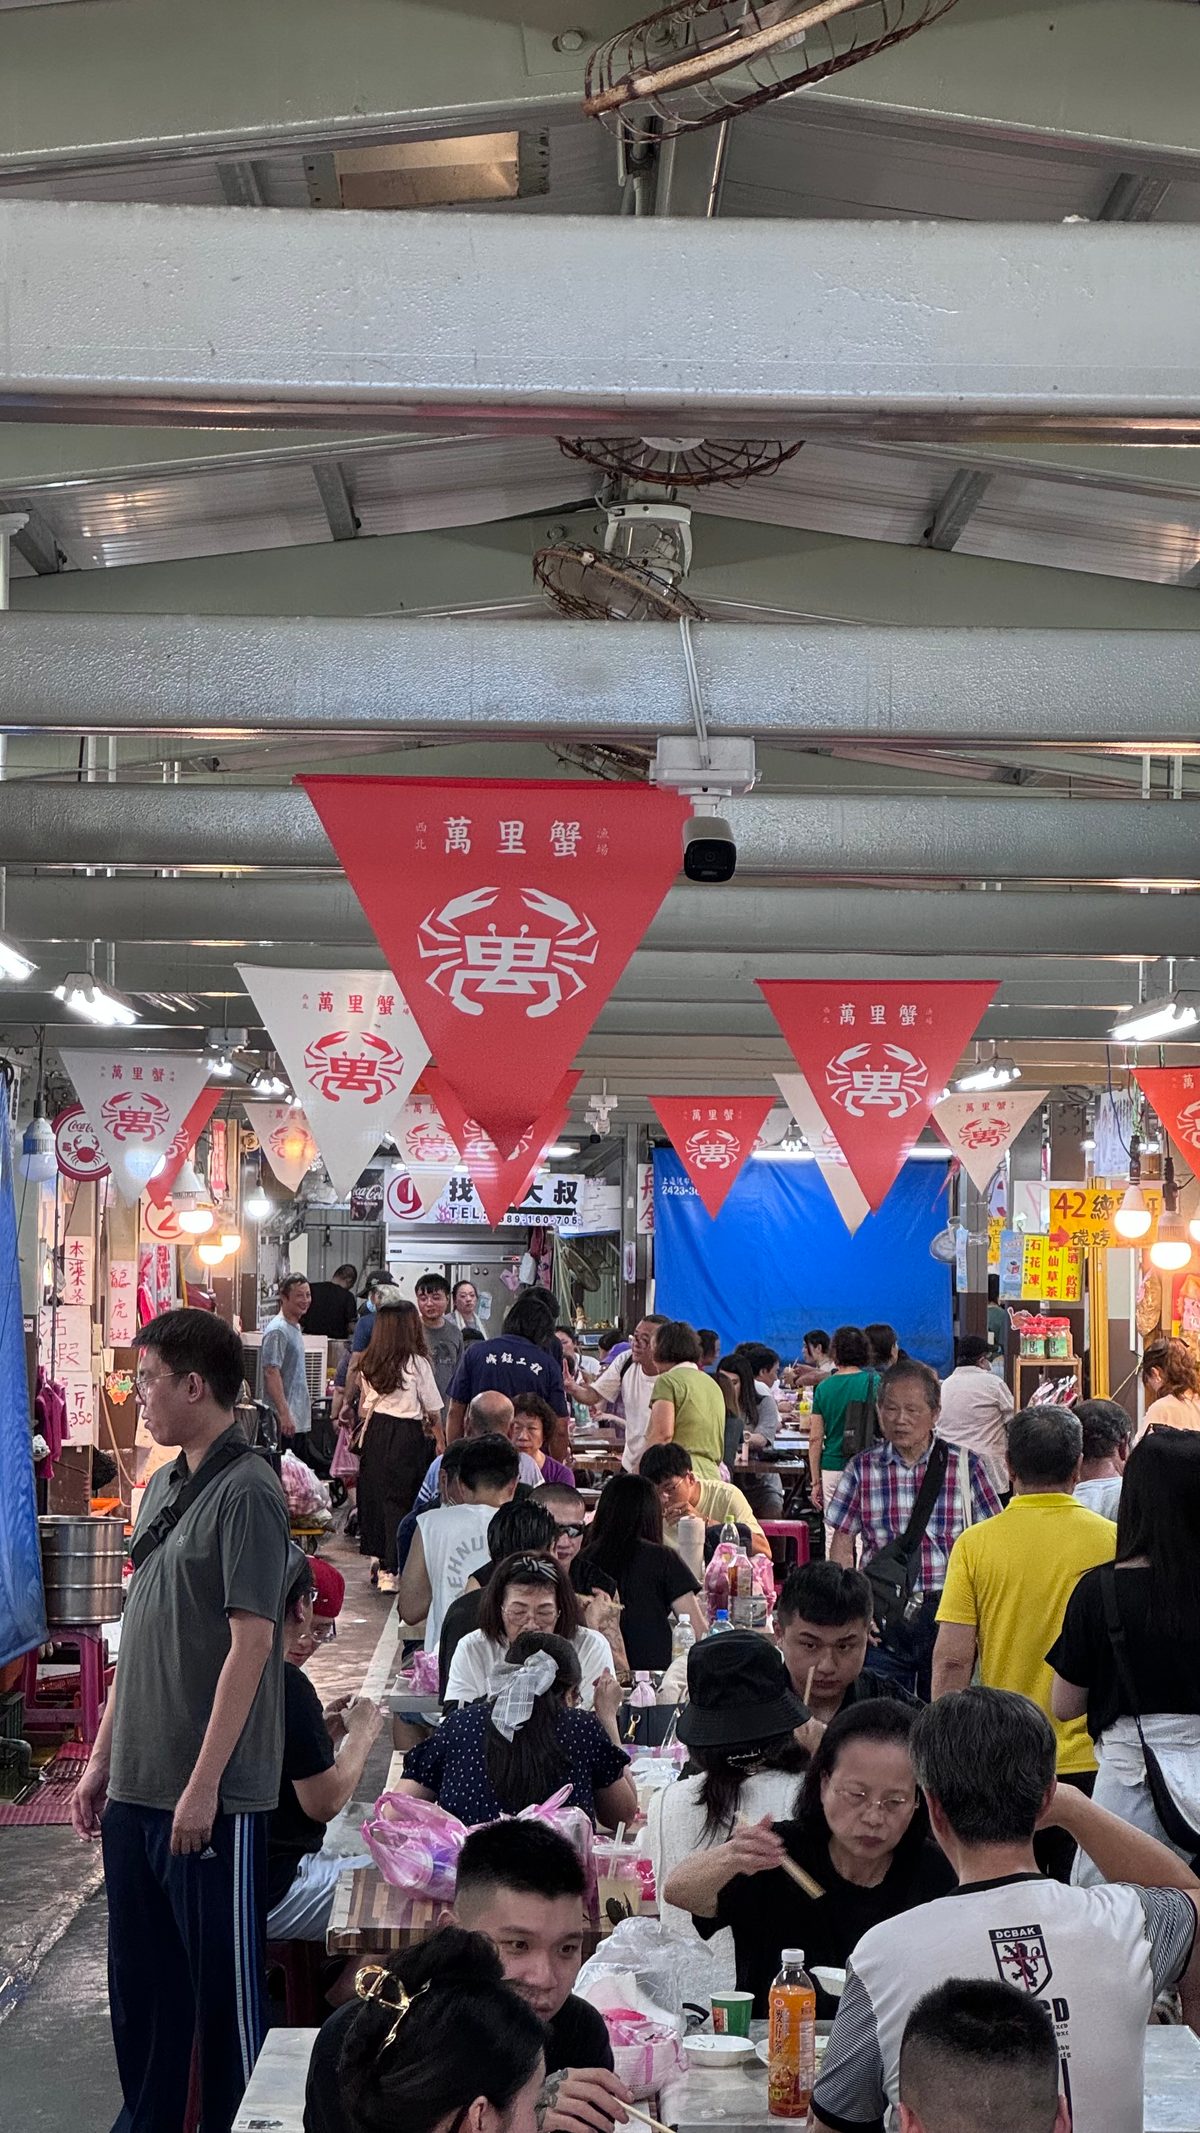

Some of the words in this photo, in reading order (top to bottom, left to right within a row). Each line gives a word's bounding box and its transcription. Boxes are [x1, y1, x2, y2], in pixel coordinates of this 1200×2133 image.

[443, 816, 582, 857] 萬里蟹
[318, 992, 395, 1015] 萬里蟹
[839, 1003, 918, 1025] 萬里蟹
[111, 1064, 165, 1082] 萬里蟹
[500, 1214, 577, 1225] 89-160-705
[1029, 1238, 1042, 1286] 石花凍
[1046, 1246, 1059, 1298] 仙草茶
[40, 1310, 80, 1368] 活蝦
[995, 1927, 1036, 1940] DCBAK
